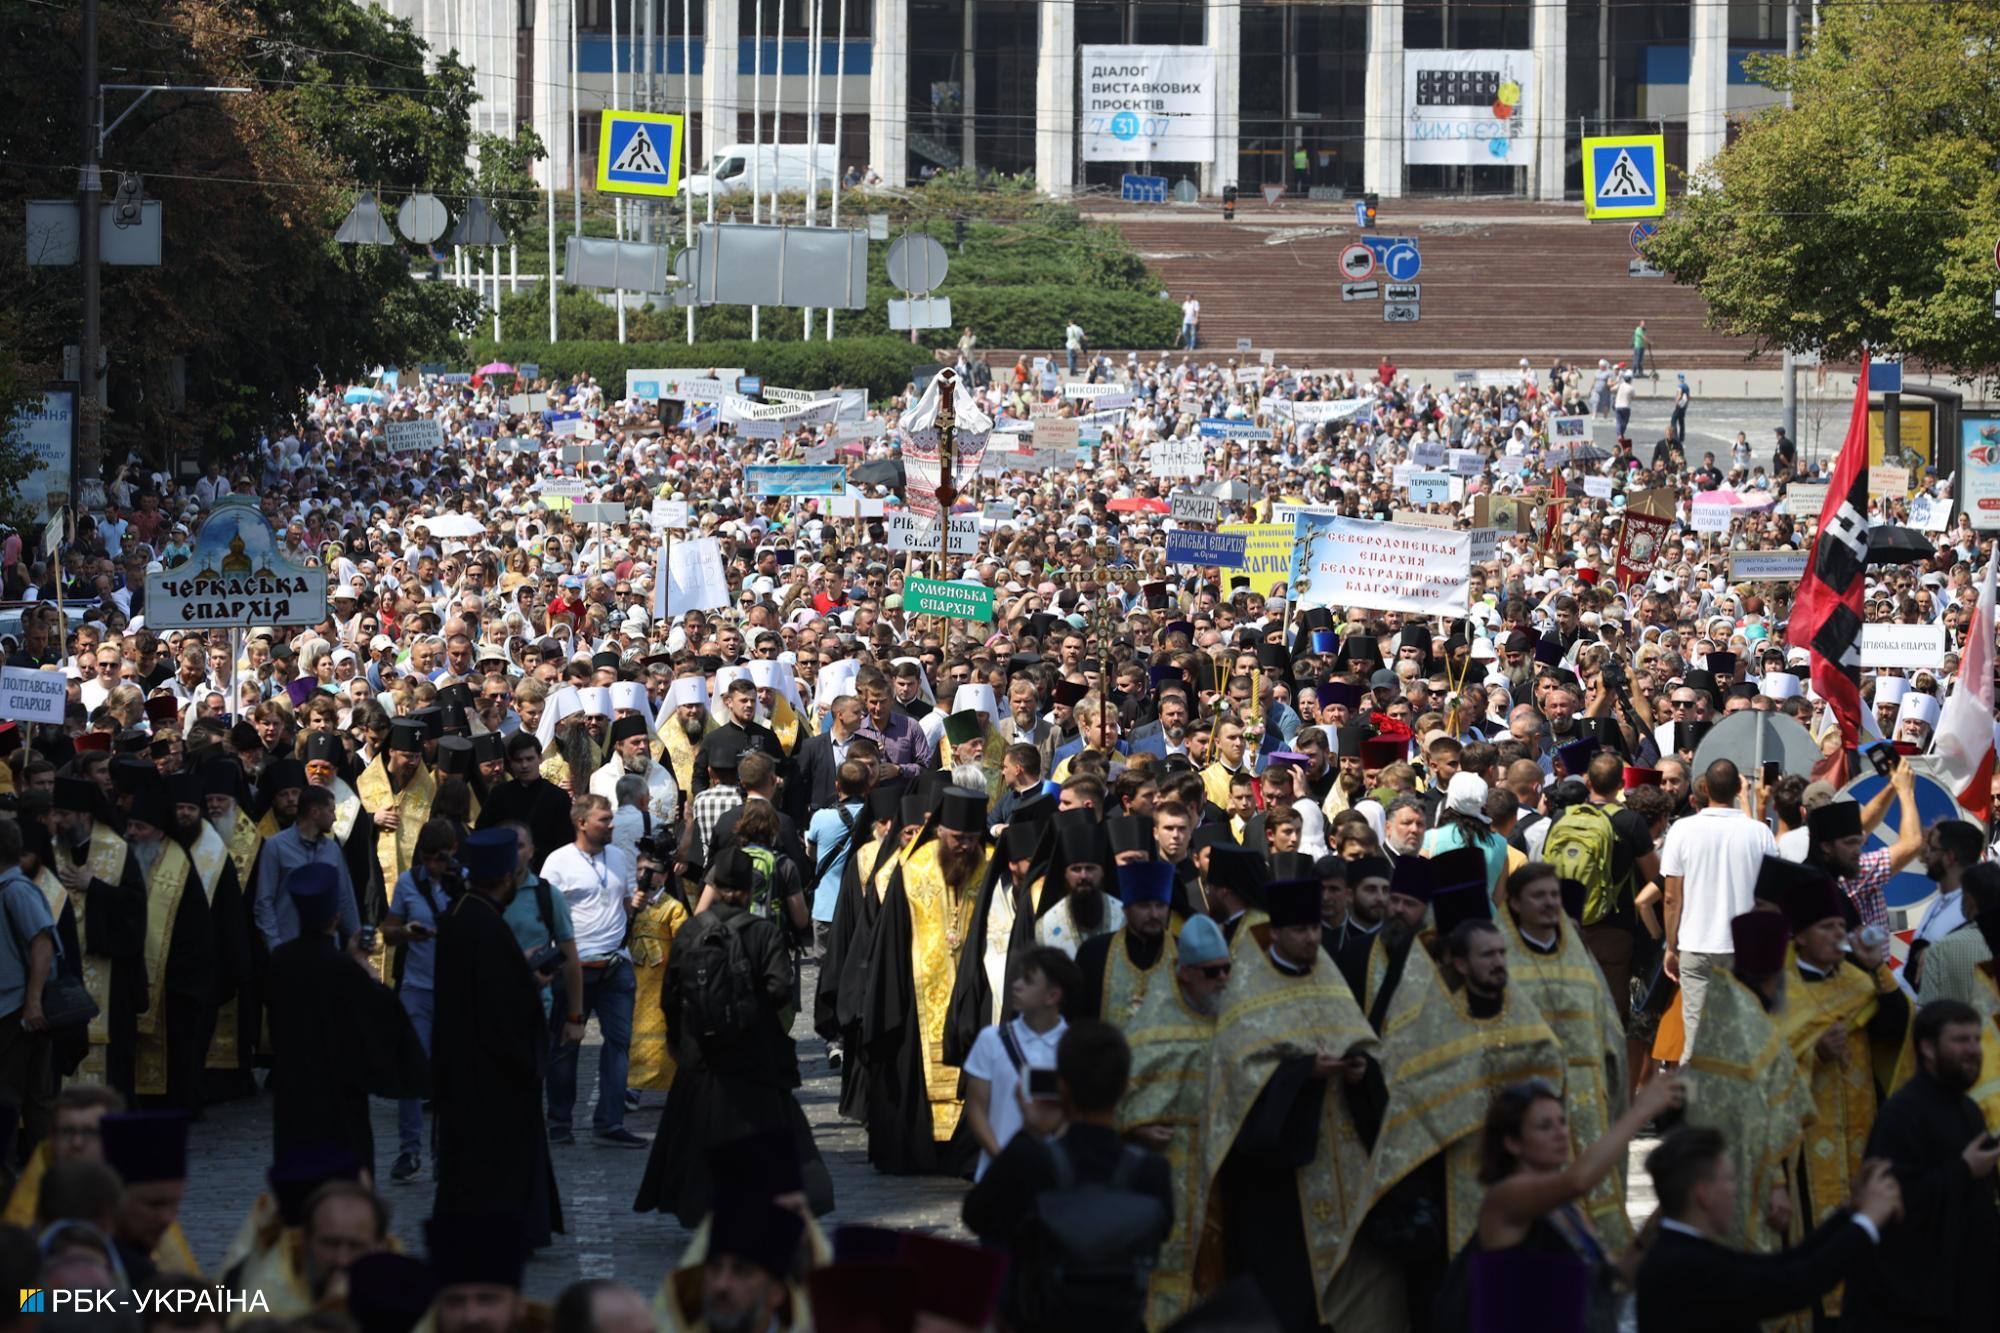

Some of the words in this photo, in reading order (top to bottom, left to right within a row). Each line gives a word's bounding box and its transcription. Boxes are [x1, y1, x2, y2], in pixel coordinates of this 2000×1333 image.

[1091, 66, 1149, 79] ДІАЛОГ
[1091, 83, 1201, 94] ВИСТАВКОВИХ
[1091, 99, 1165, 111] ПРОЄКТІВ
[1419, 95, 1456, 105] ТИП
[1115, 117, 1135, 136] 31
[1143, 118, 1170, 137] 07
[1415, 121, 1451, 141] КИМ
[1456, 122, 1469, 139] Я
[764, 389, 814, 402] НІКОПОЛЬ
[1068, 387, 1121, 395] НІКОПОЛЬ
[752, 403, 802, 418] НІКОПОЛЬ
[1228, 429, 1272, 439] КРИЖОПІЛЬ
[1411, 478, 1449, 487] ТЕРНОПІЛЬ
[1425, 488, 1433, 499] 3
[1173, 498, 1215, 519] РУЖИН
[892, 516, 976, 533] РІВНЬКА
[1168, 532, 1207, 550] СУМСЬКА
[1209, 537, 1245, 553] ЄПАРХІЯ
[161, 576, 309, 600] ЧЕРКАСЬКА
[909, 581, 988, 603] РОМЕНСЬКА
[180, 597, 291, 625] ЄПАРХІЯ
[919, 597, 976, 616] ЄПАРХІЯ
[1862, 640, 1900, 651] ІГІВСЬКА
[1900, 641, 1937, 651] ЄПАРХІЯ
[2, 677, 64, 695] ПОЛТАВСЬКА
[10, 695, 52, 712] ЄПАРХІЯ
